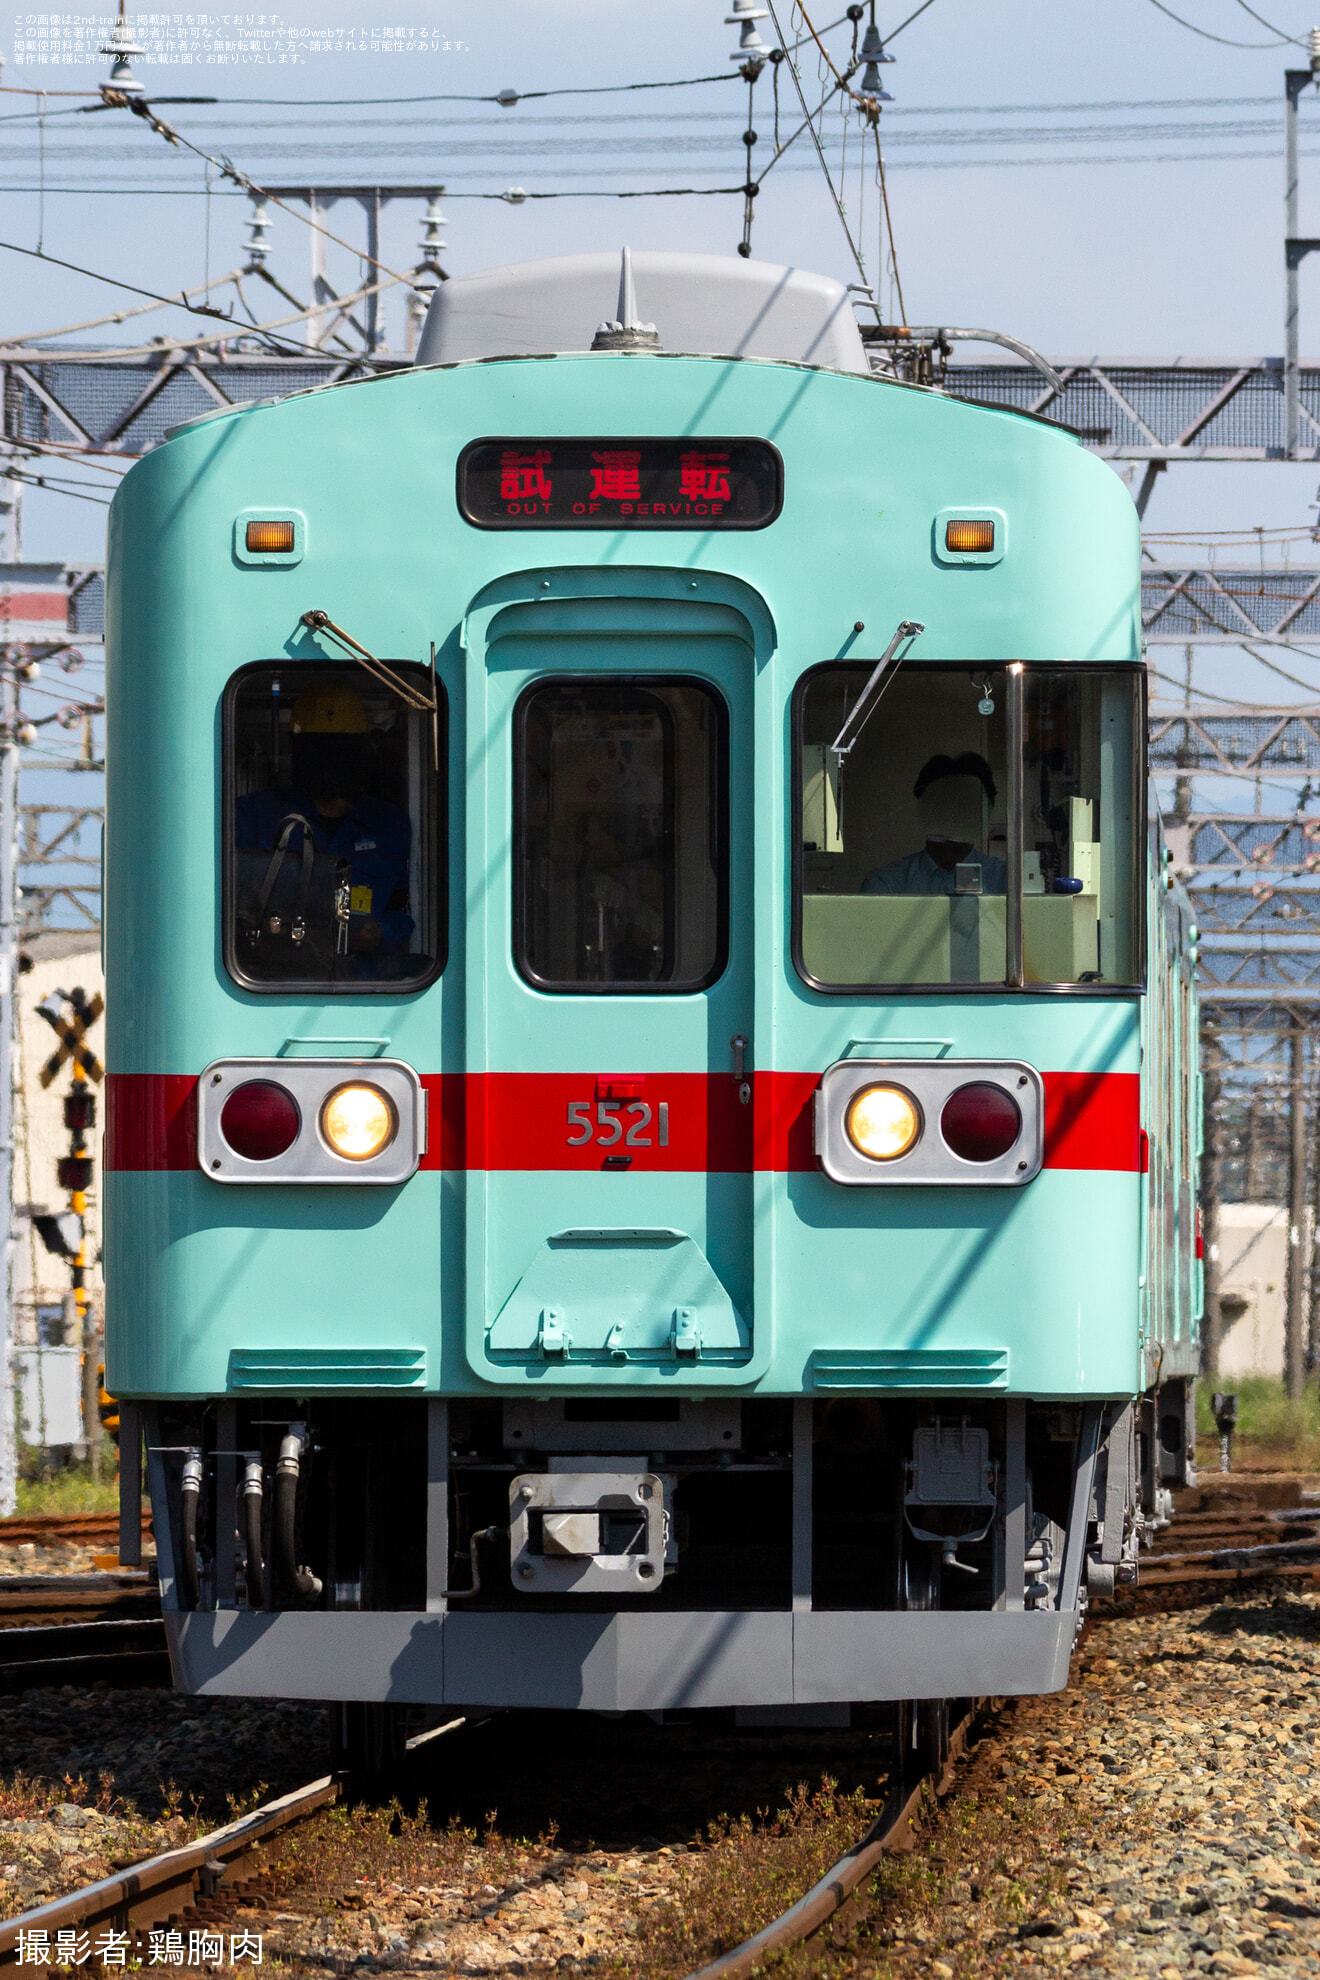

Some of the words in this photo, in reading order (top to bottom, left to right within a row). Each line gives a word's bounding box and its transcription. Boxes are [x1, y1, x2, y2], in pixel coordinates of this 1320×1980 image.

[507, 503, 553, 515] OUT
[572, 503, 601, 515] OF
[620, 503, 723, 515] SERVICE
[566, 1102, 669, 1147] 5521
